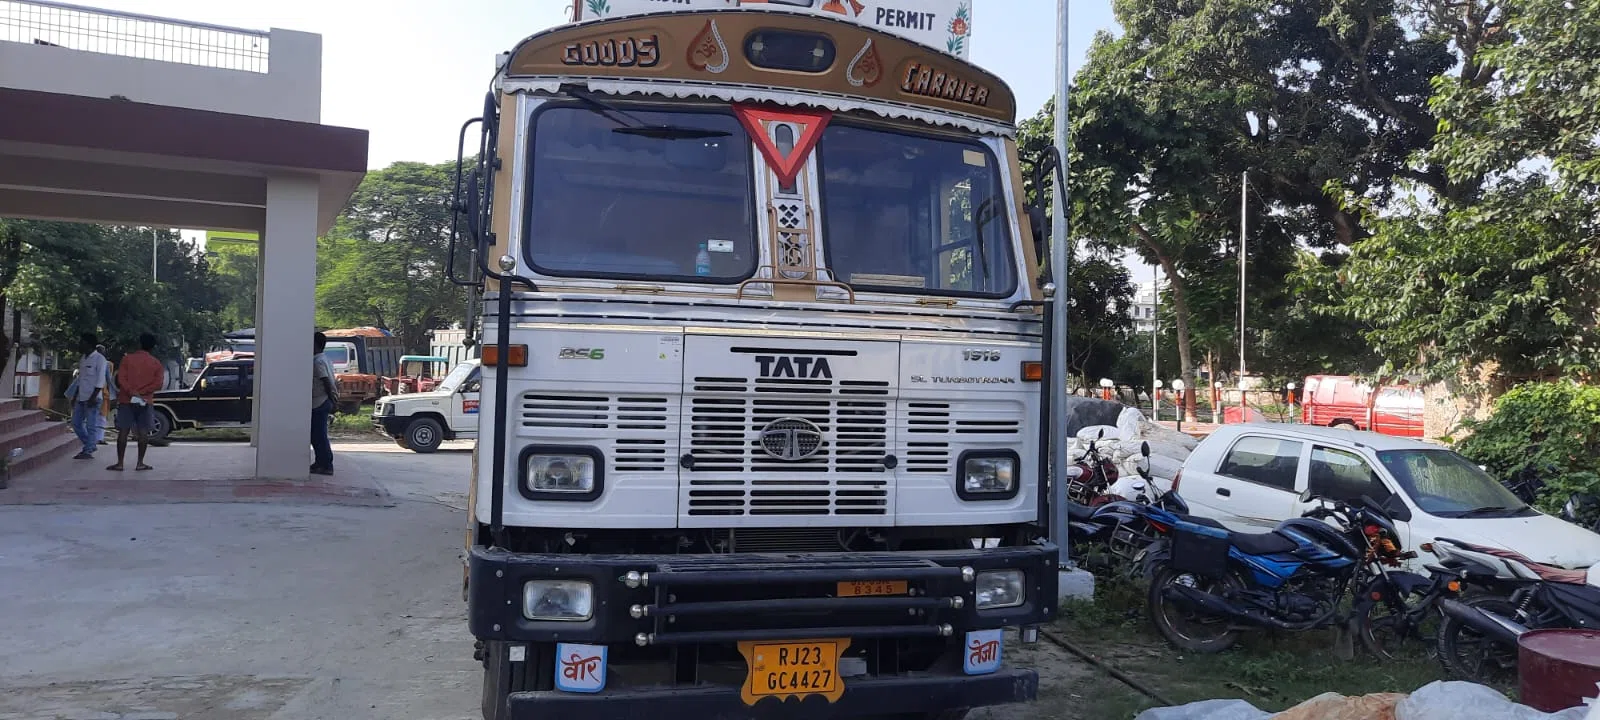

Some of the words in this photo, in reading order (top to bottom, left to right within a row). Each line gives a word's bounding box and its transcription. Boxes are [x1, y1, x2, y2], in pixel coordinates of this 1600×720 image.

[875, 7, 936, 31] PERMIT
[561, 34, 661, 68] GOODS
[900, 59, 990, 106] CARRIER
[755, 355, 833, 379] TATA
[779, 646, 821, 666] RJ23
[968, 639, 1000, 667] तेजा
[560, 653, 602, 683] वीर
[767, 669, 831, 690] GC4427
